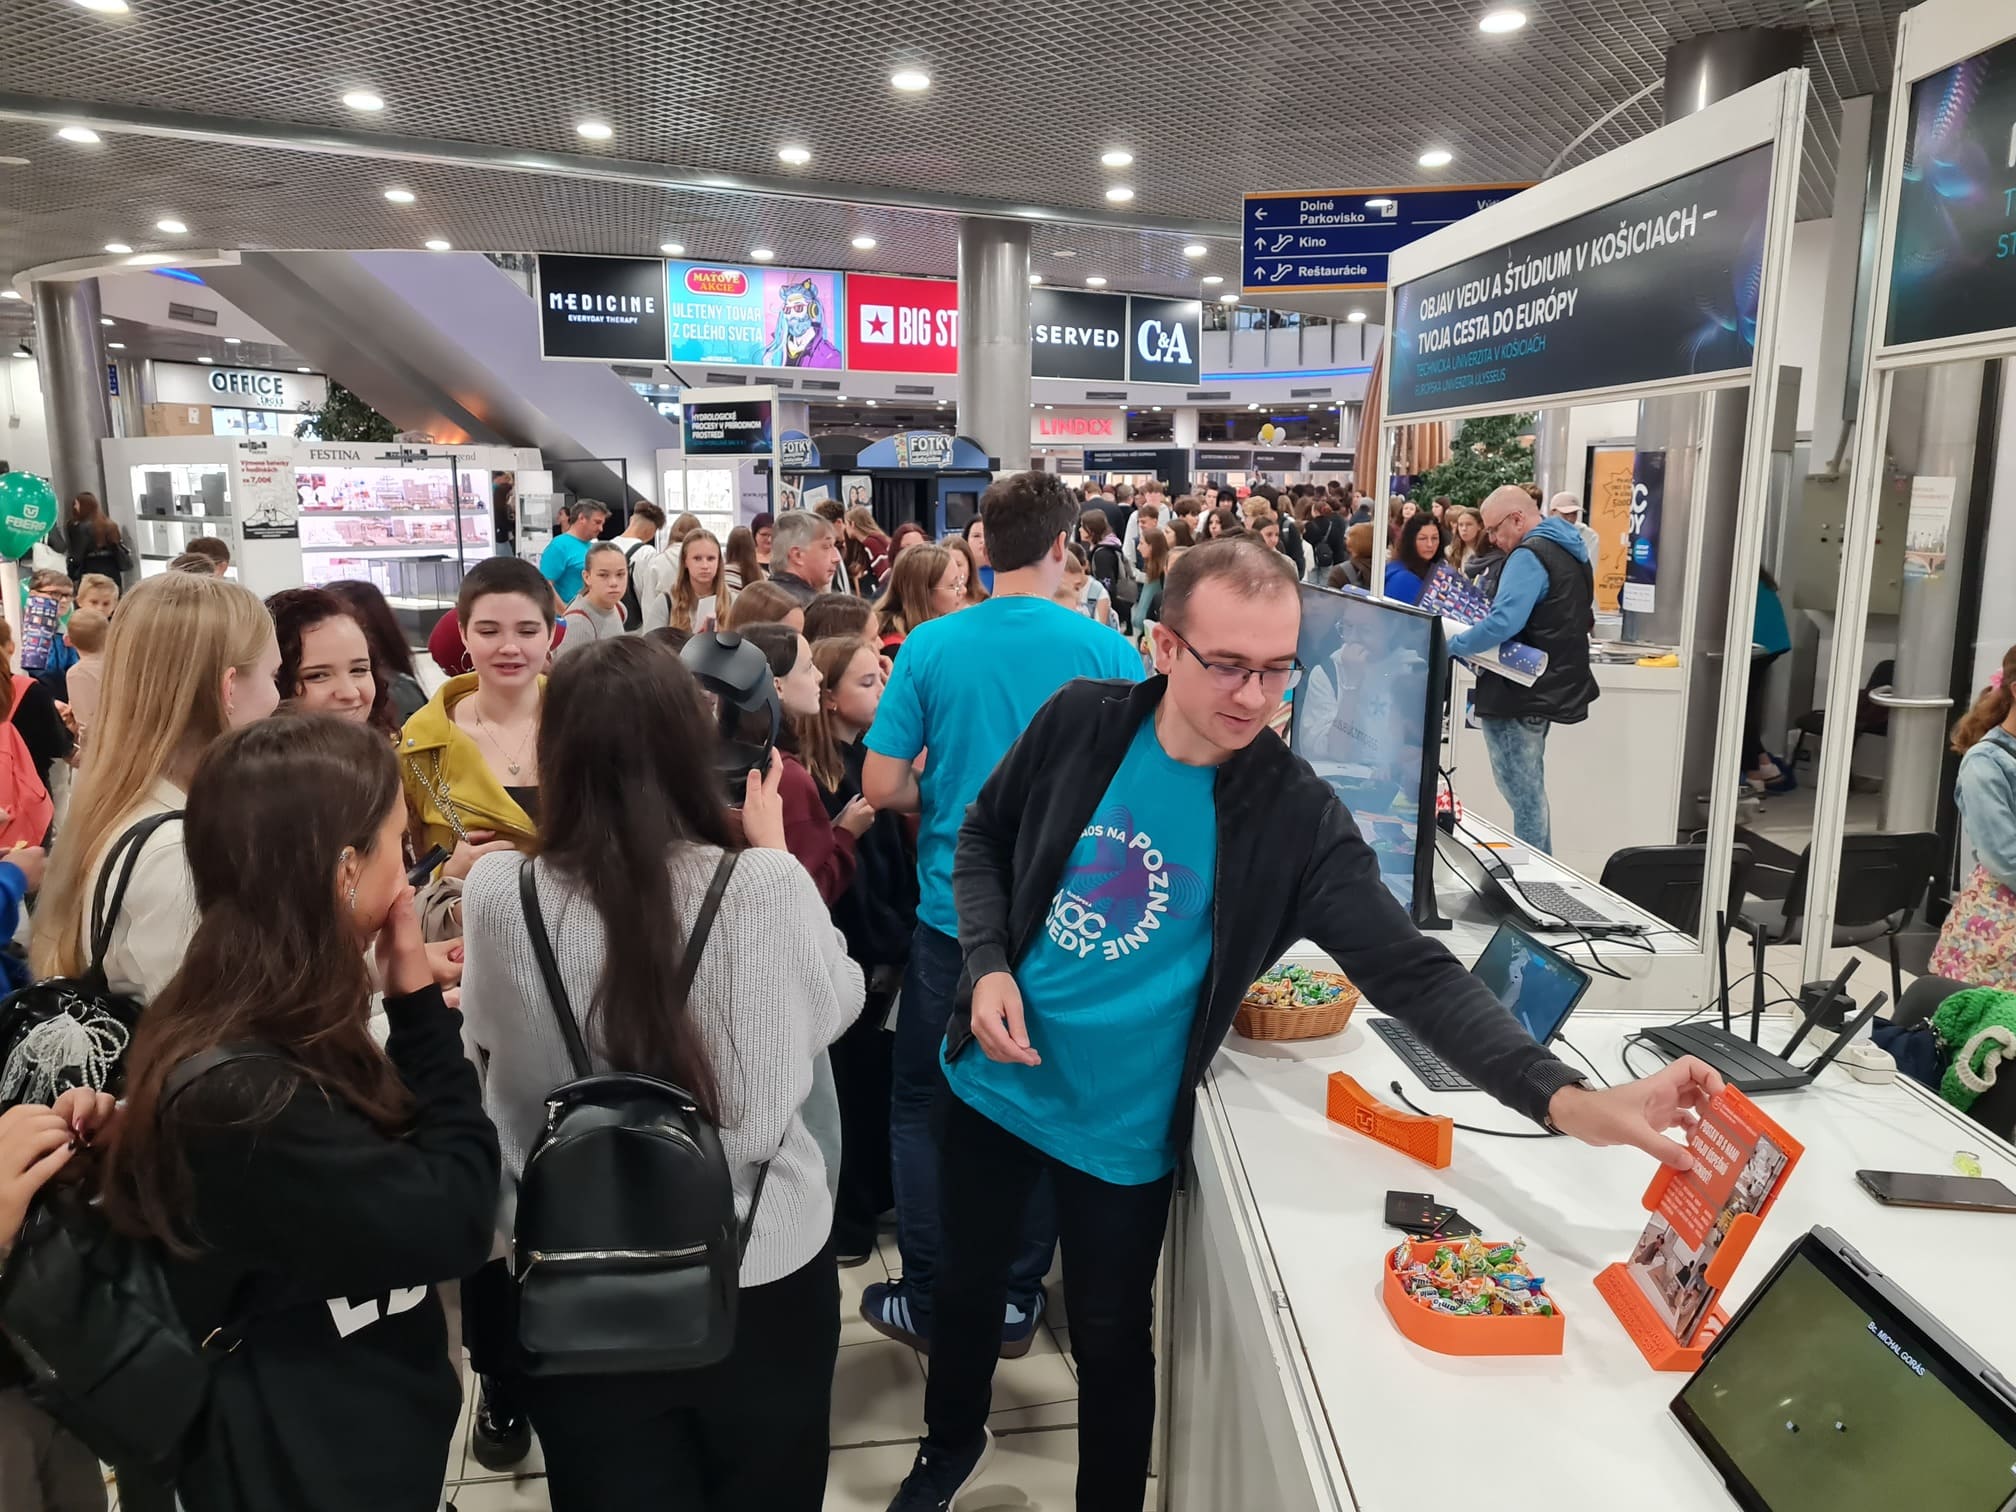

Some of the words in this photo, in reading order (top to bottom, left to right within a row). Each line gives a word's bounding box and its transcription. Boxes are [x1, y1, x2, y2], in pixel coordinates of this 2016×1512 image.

[1300, 200, 1334, 211] Dolné
[1300, 212, 1365, 225] Parkovisko
[1298, 236, 1327, 248] Kino
[1298, 264, 1368, 277] Reštaurácie
[1420, 284, 1455, 321] OBJAV
[1457, 275, 1491, 308] VEDU
[1491, 272, 1502, 299] A
[1504, 247, 1572, 295] ŠTÚDIUM
[1575, 241, 1589, 271] V
[1590, 203, 1698, 268] KOŠICIACH
[700, 282, 735, 293] AKCIE
[549, 292, 655, 314] MEDICINE
[568, 314, 604, 323] EVERYDAY
[605, 316, 638, 325] THERAPY
[726, 304, 762, 322] TOVAR
[1418, 324, 1451, 355] TVOJA
[1453, 312, 1490, 346] CESTA
[1491, 305, 1513, 337] DO
[1516, 286, 1578, 330] EURÓPY
[672, 322, 680, 338] Z
[682, 322, 726, 341] CELÉHO
[728, 325, 763, 343] SVETA
[899, 306, 931, 346] BIG
[1031, 324, 1120, 348] SERVED
[1137, 319, 1193, 364] C&A
[210, 371, 284, 395] OFFICE
[692, 422, 718, 430] PROCESY
[1039, 418, 1113, 436] LINDEX
[782, 441, 812, 453] FOTKY
[910, 437, 952, 451] FOTKY
[310, 449, 360, 461] FESTINA
[1107, 826, 1126, 843] NA
[1102, 831, 1170, 961] POZNANIE
[1877, 1329, 1901, 1355] MICHAL
[1900, 1351, 1926, 1376] GORÁS
